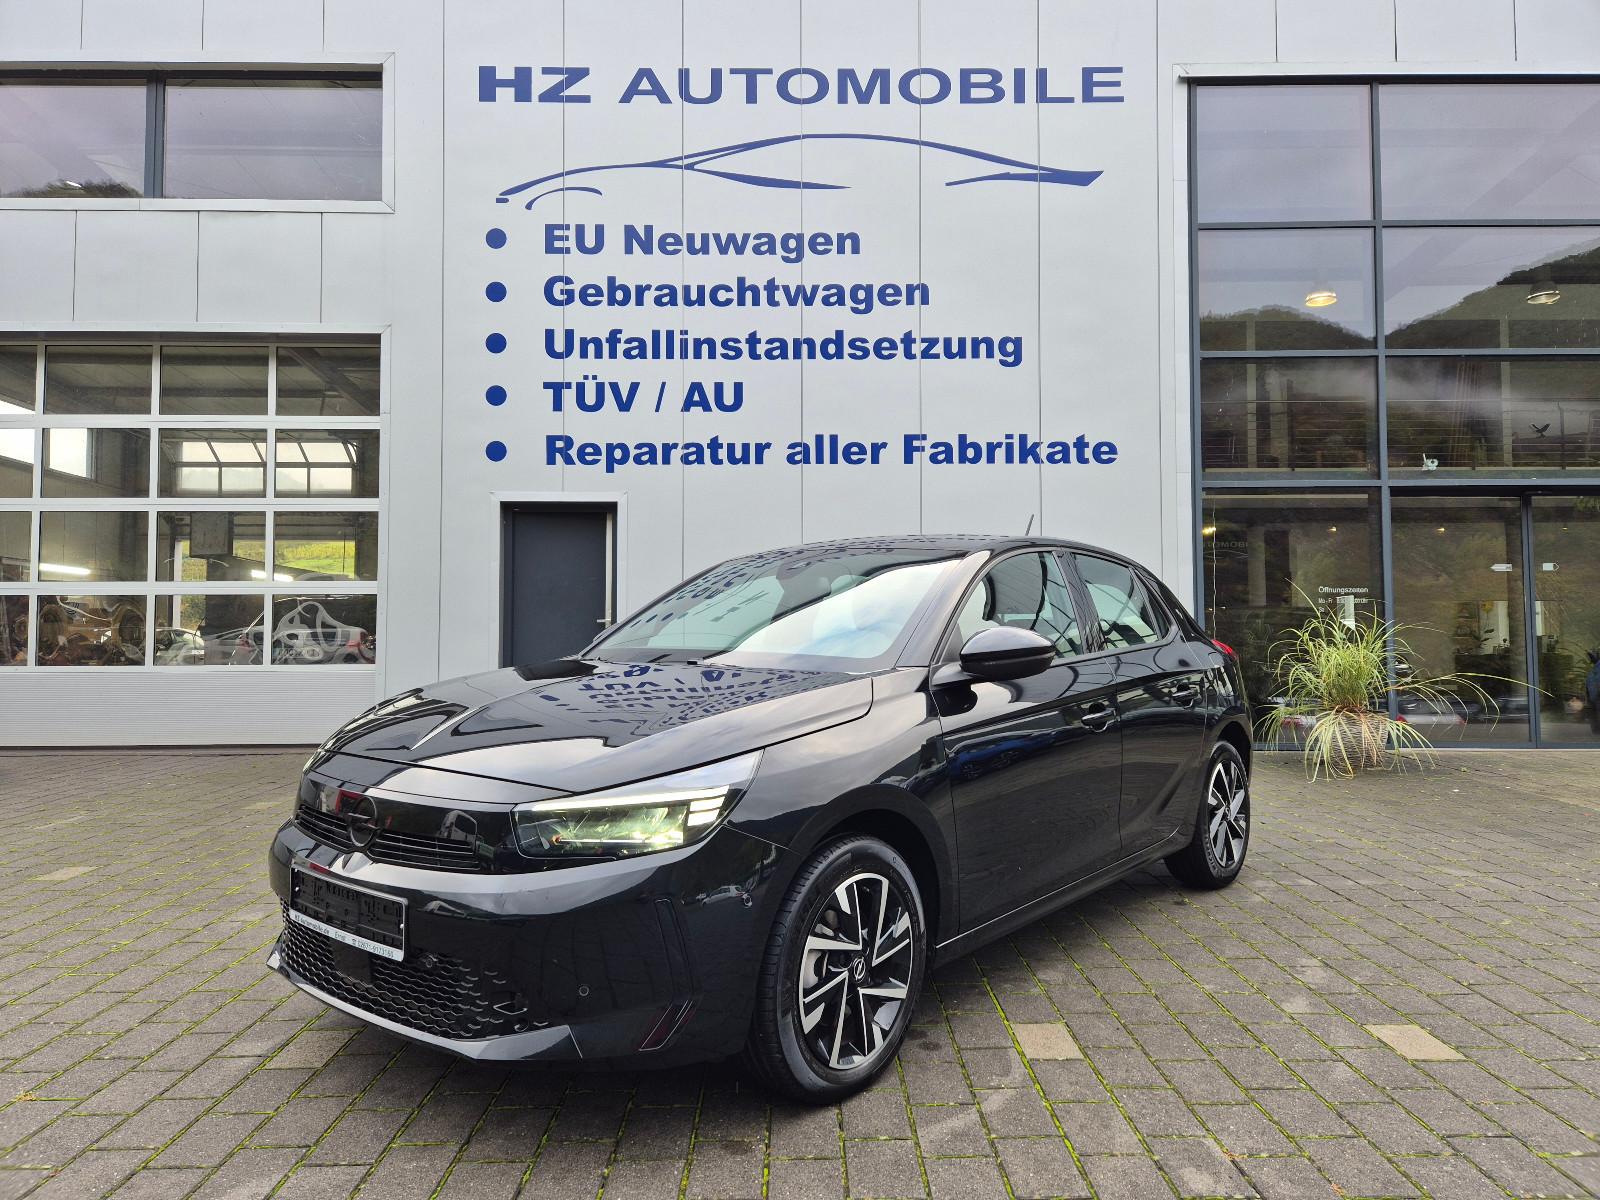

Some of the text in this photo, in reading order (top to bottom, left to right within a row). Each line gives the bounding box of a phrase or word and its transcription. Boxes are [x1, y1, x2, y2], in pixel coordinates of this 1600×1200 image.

[479, 66, 1124, 105] HZ AUTOMOBILE
[544, 223, 861, 264] EU Neuwagen
[543, 275, 930, 315] Gebrauchtwagen
[544, 328, 1023, 368] Unfallinstandsetzung
[543, 374, 744, 413] TÜV / AU
[545, 433, 1119, 474] Reparatur aller Fabrikate
[1318, 585, 1369, 594] Öffnungszeiten
